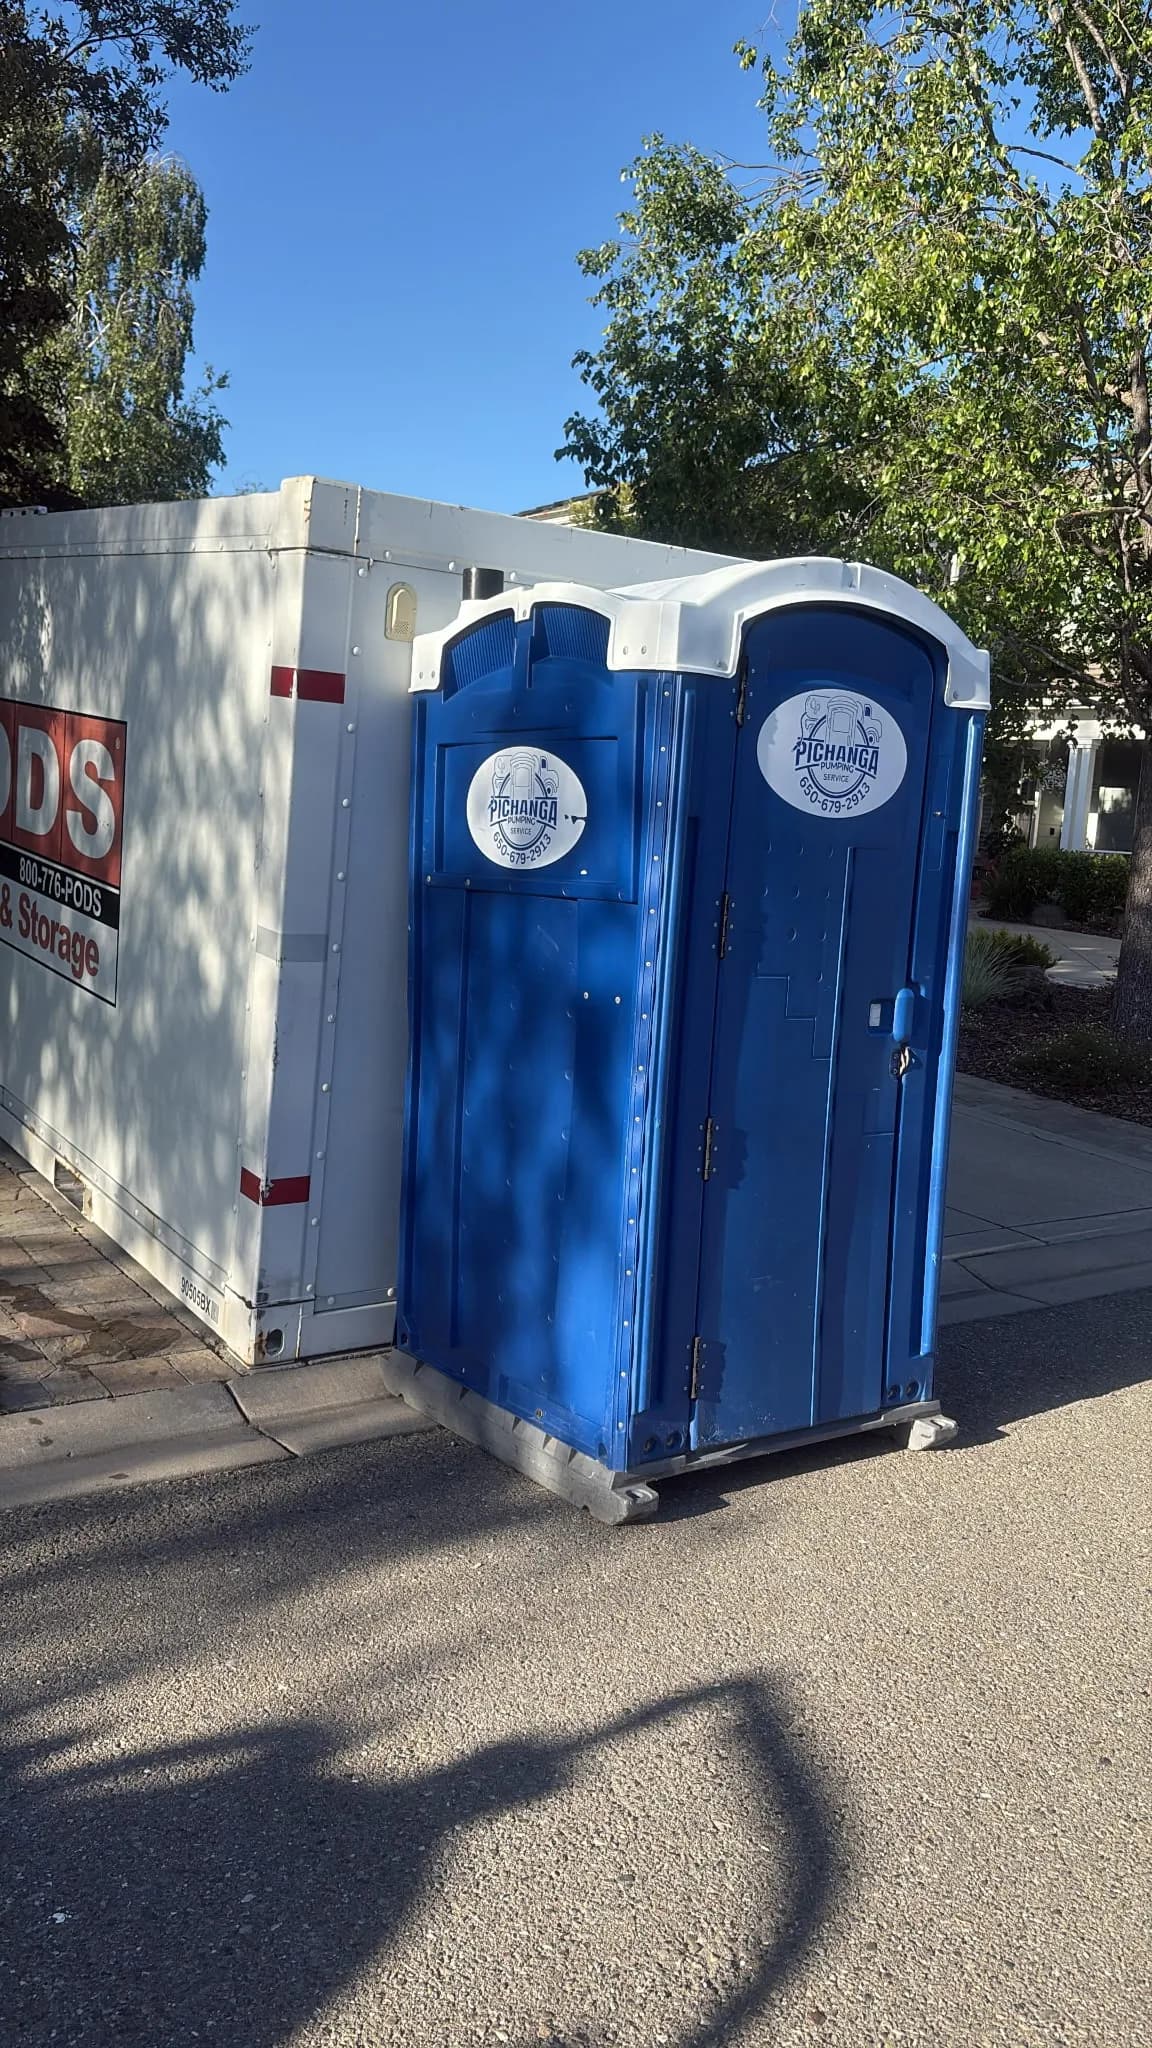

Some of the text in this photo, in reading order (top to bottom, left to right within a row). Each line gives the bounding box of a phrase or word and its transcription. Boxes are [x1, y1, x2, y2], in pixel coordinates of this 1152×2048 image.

[795, 740, 879, 774] PICHANGA
[820, 762, 854, 773] PUMPING
[0, 721, 116, 859] DS
[799, 776, 870, 813] 650-679-2913
[823, 773, 849, 783] SERVICE
[490, 798, 557, 826] PICHANGA
[508, 815, 536, 825] PUMPING
[493, 831, 551, 864] 650-679-2913
[510, 827, 532, 835] SERVICE
[19, 857, 103, 917] 800-776-PODS
[0, 883, 100, 979] & Storage
